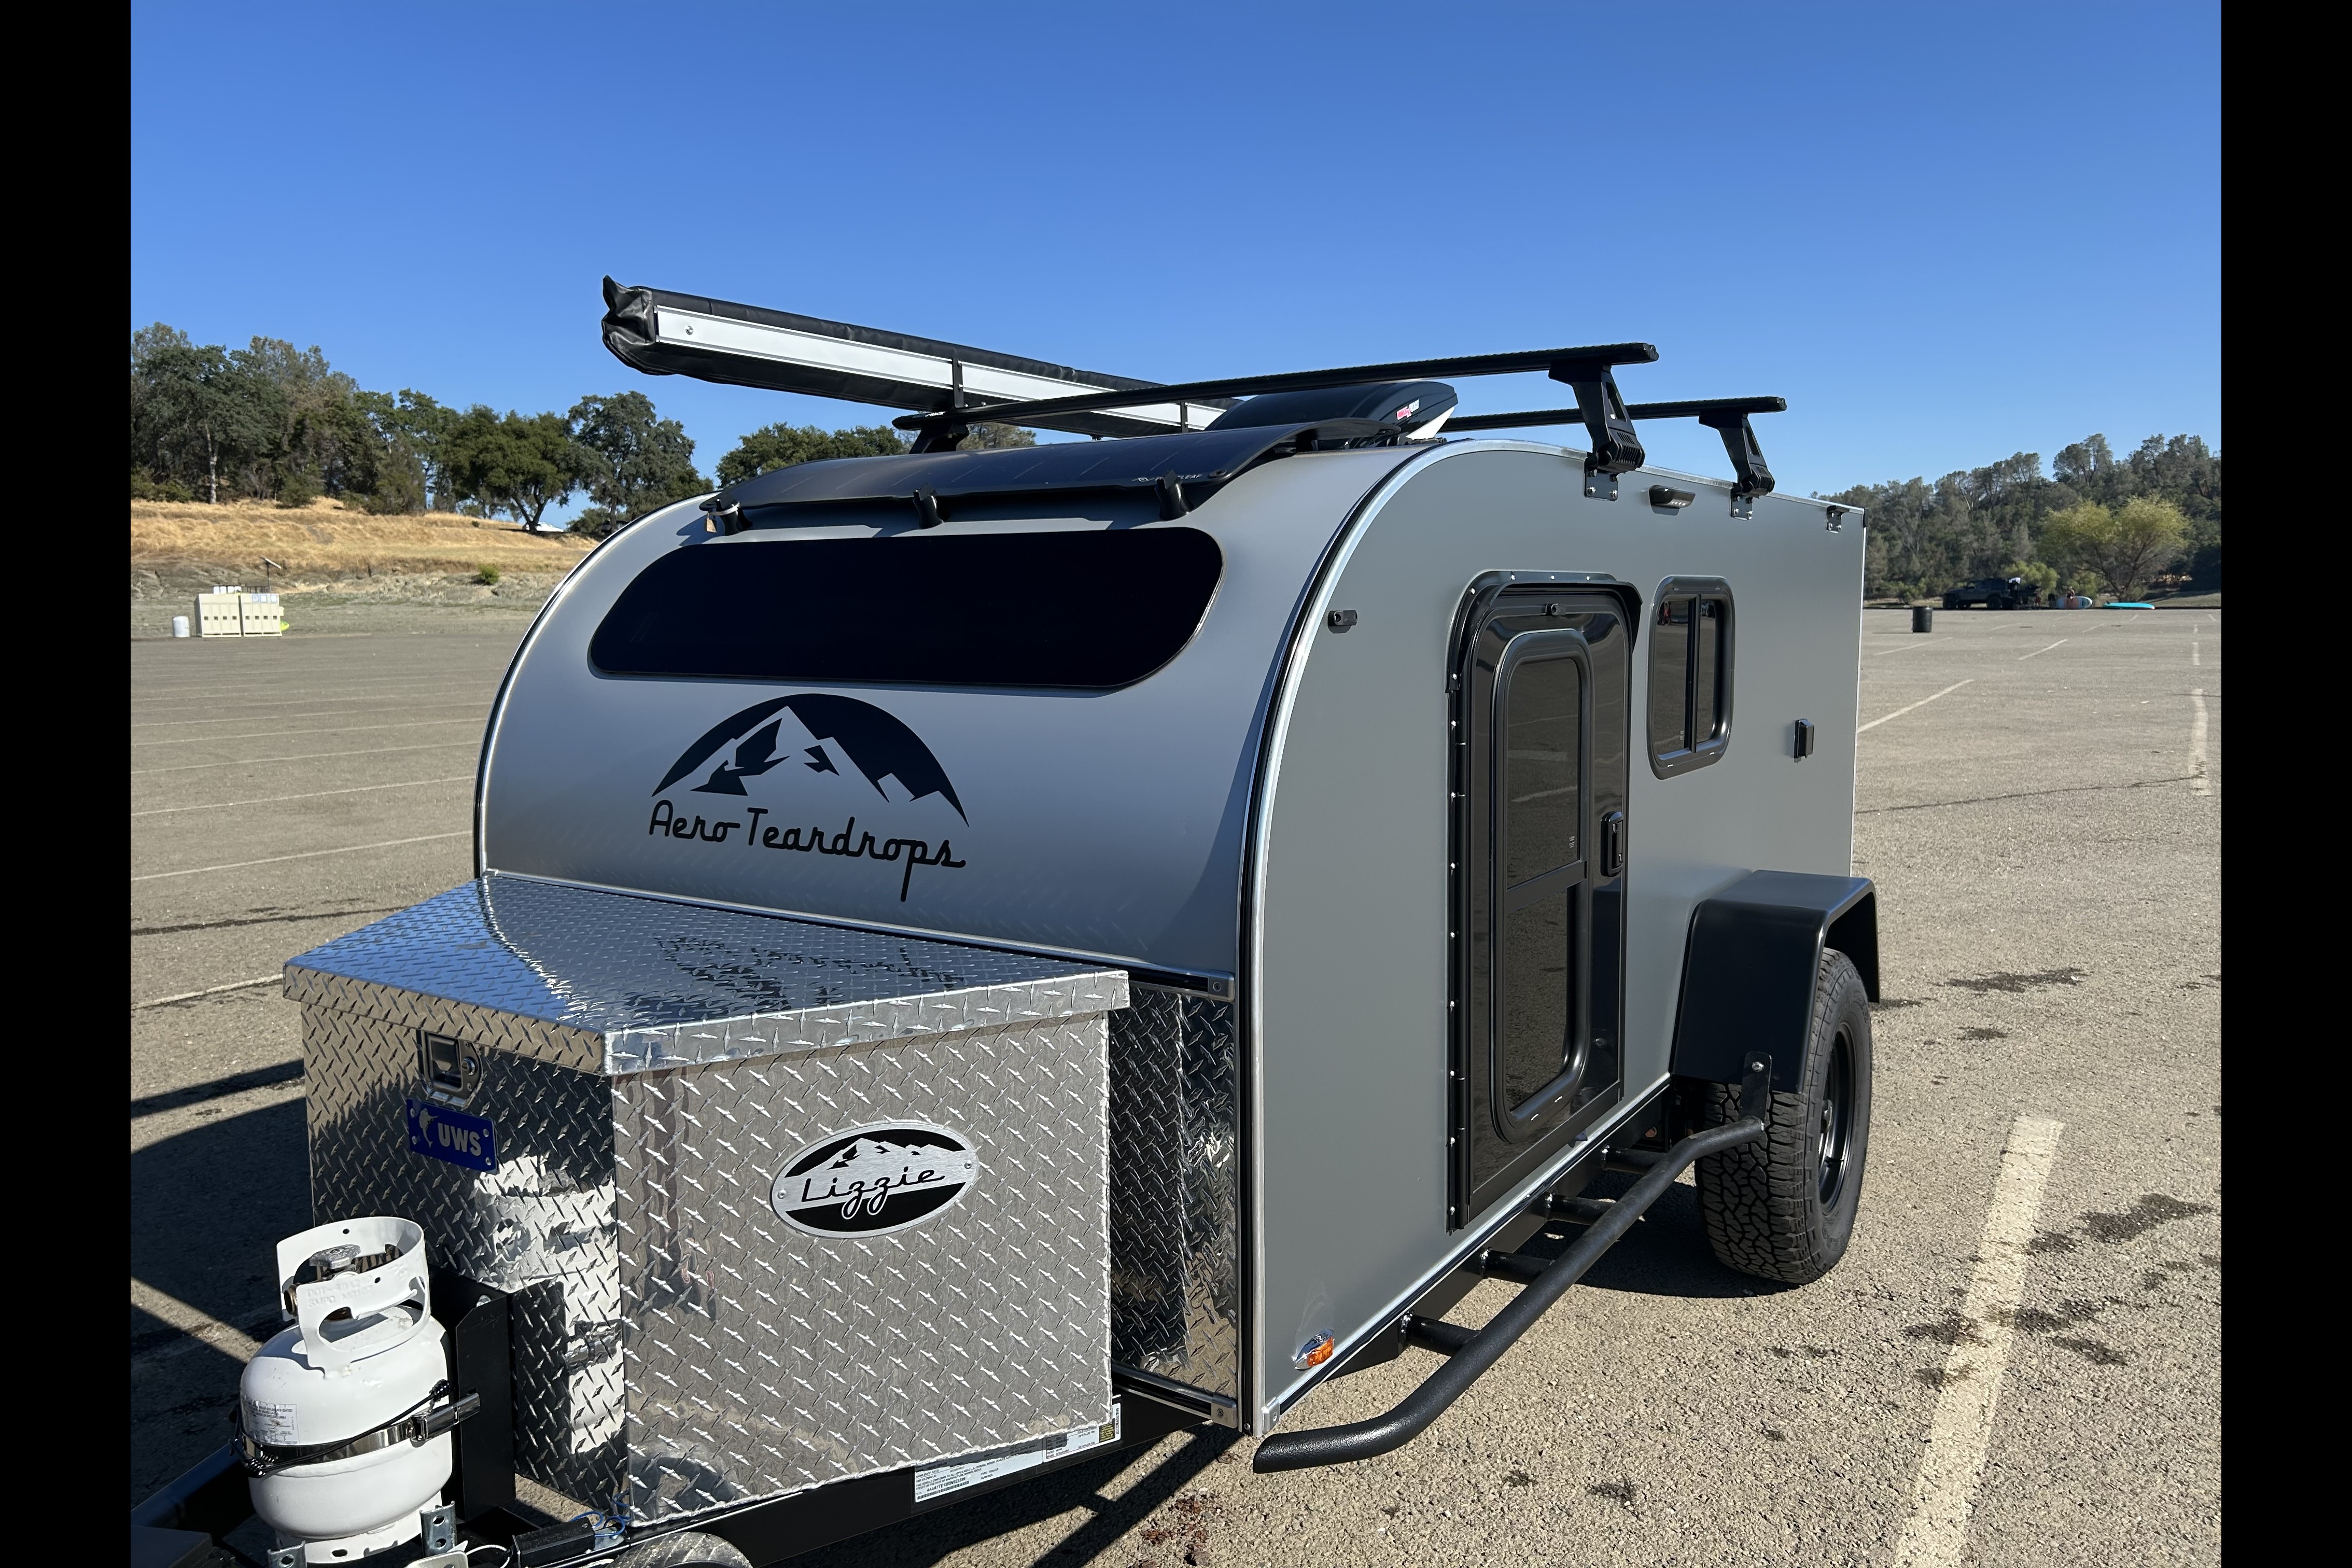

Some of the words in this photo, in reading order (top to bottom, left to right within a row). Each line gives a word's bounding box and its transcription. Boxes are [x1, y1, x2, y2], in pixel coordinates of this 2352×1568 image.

[649, 800, 740, 843] Aero
[747, 807, 966, 902] Teardrops
[438, 1123, 482, 1156] UWS
[801, 1166, 946, 1220] Lizzie
